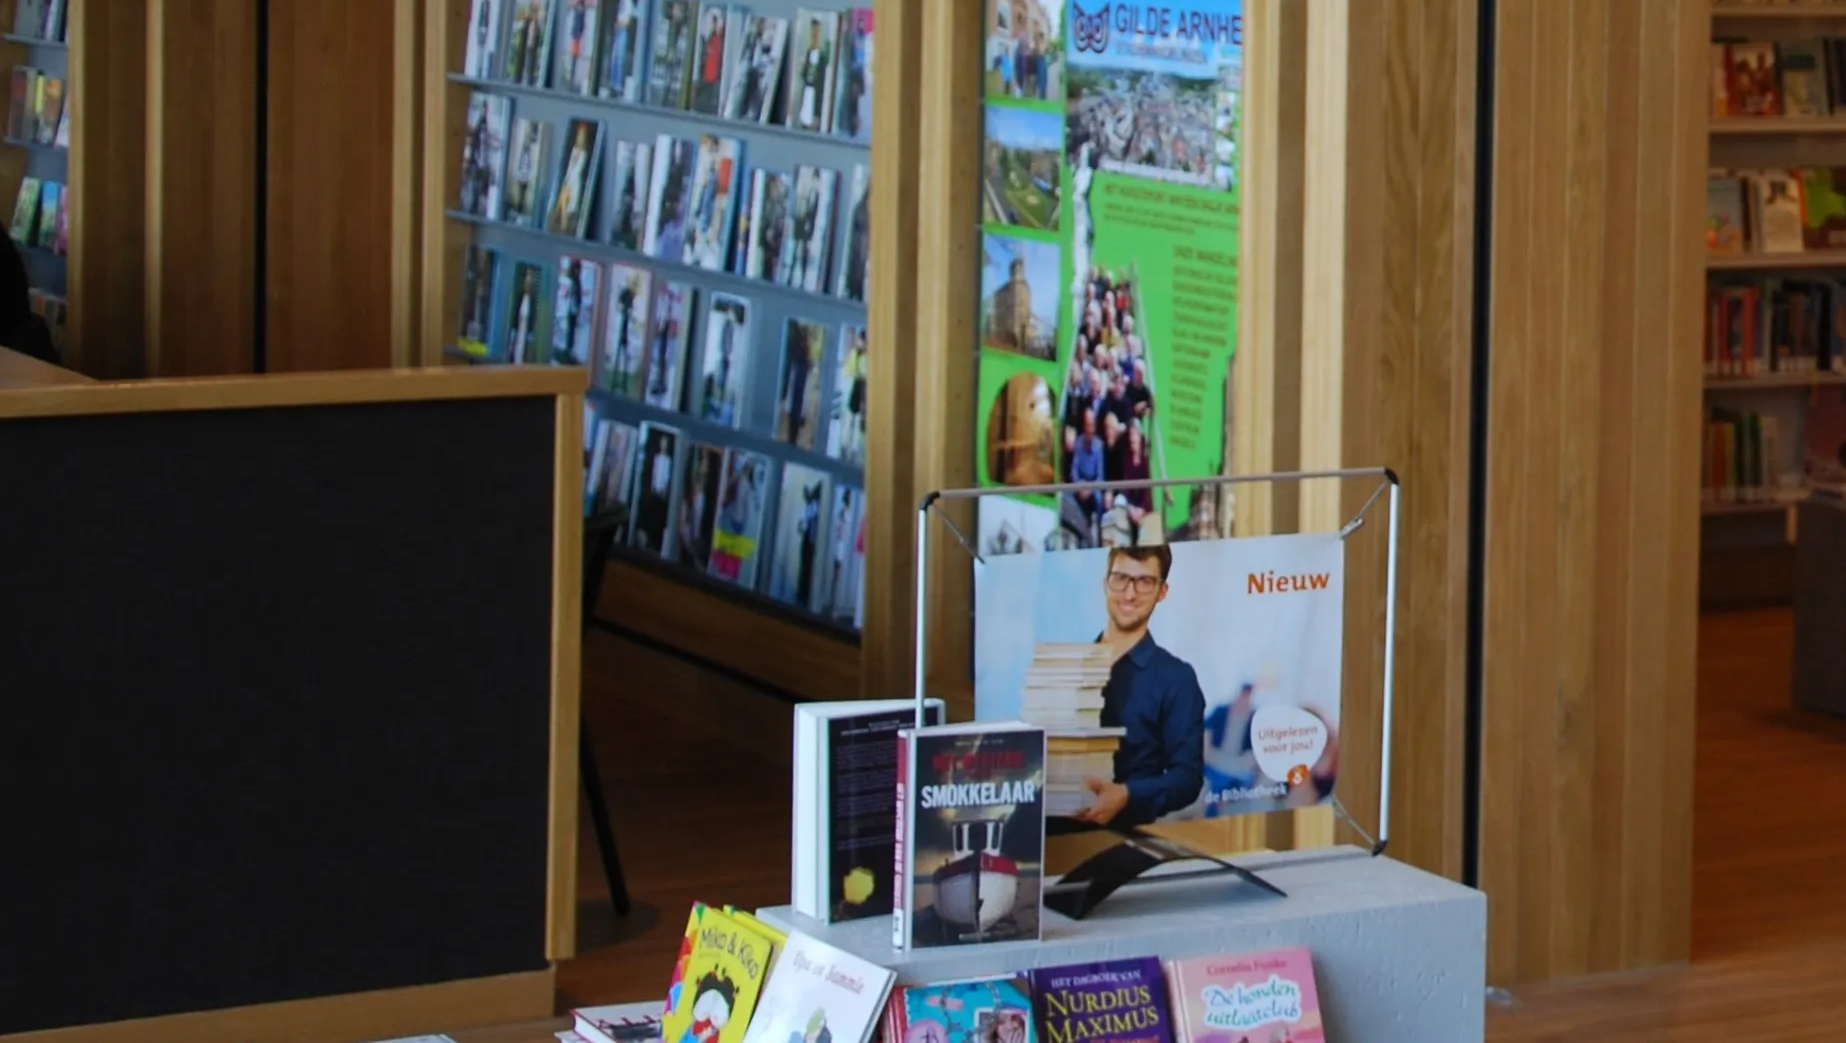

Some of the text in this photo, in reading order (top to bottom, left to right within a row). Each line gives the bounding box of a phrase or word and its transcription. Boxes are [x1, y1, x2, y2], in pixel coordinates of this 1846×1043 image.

[1115, 3, 1171, 37] GILDE
[1247, 570, 1330, 595] Nieuw
[921, 781, 1036, 809] SMOKKELAAR
[700, 926, 728, 951] Miko
[1051, 967, 1141, 989] HET DAGBOEK VAN
[1044, 984, 1152, 1018] NURDIUS
[1045, 1005, 1160, 1043] MAXIMUS
